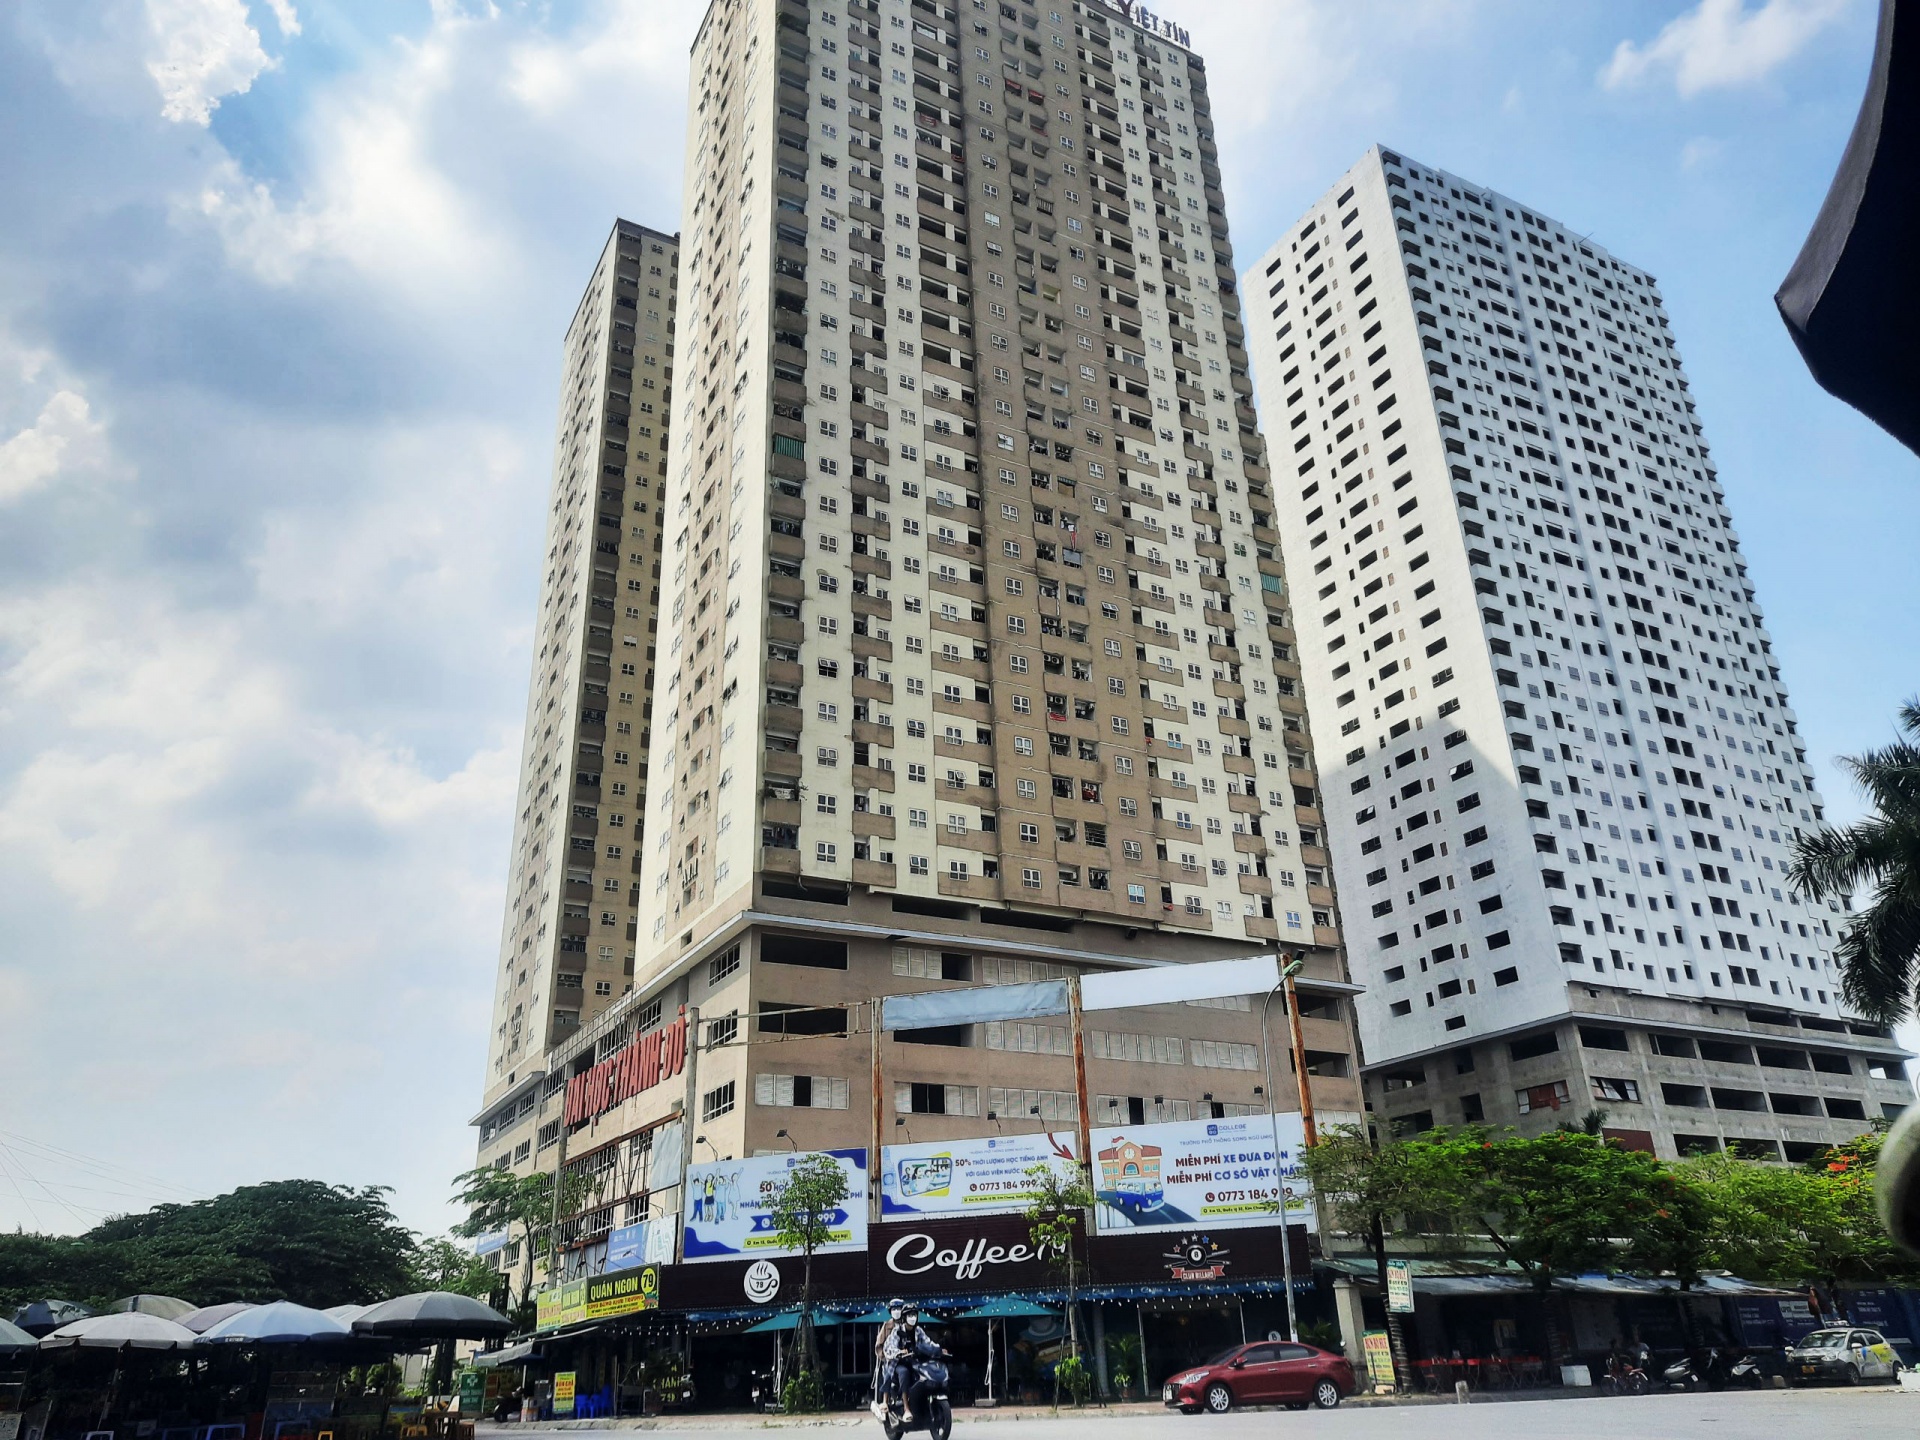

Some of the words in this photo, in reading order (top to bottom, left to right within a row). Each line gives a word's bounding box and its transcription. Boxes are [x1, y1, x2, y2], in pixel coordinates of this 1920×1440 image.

[563, 1070, 587, 1134] ĐẠI
[585, 1058, 615, 1127] HỌC
[613, 1029, 664, 1105] THÀNH
[1218, 1123, 1247, 1131] COLLEGE
[955, 1159, 971, 1167] 50%
[972, 1157, 985, 1166] THỜI
[1006, 1156, 1018, 1164] HỌC
[1020, 1154, 1036, 1163] TIẾNG
[1036, 1154, 1048, 1162] ANH
[1176, 1153, 1202, 1167] MIỄN
[1204, 1153, 1220, 1165] PHÍ
[1223, 1154, 1236, 1163] XE
[1239, 1151, 1261, 1162] ĐƯA
[1167, 1170, 1193, 1184] MIỄN
[1195, 1171, 1212, 1182] PHÍ
[1214, 1170, 1231, 1181] CƠ
[1234, 1166, 1249, 1180] SỞ
[1251, 1167, 1271, 1180] VẬT
[979, 1181, 1000, 1192] 0773
[1002, 1180, 1018, 1191] 184
[1020, 1179, 1037, 1189] 999
[1218, 1190, 1245, 1202] 0773
[1249, 1188, 1268, 1200] 184
[886, 1233, 1035, 1280] Coffee
[590, 1279, 612, 1302] QUÁN
[614, 1276, 639, 1295] NGON
[642, 1273, 654, 1288] 79
